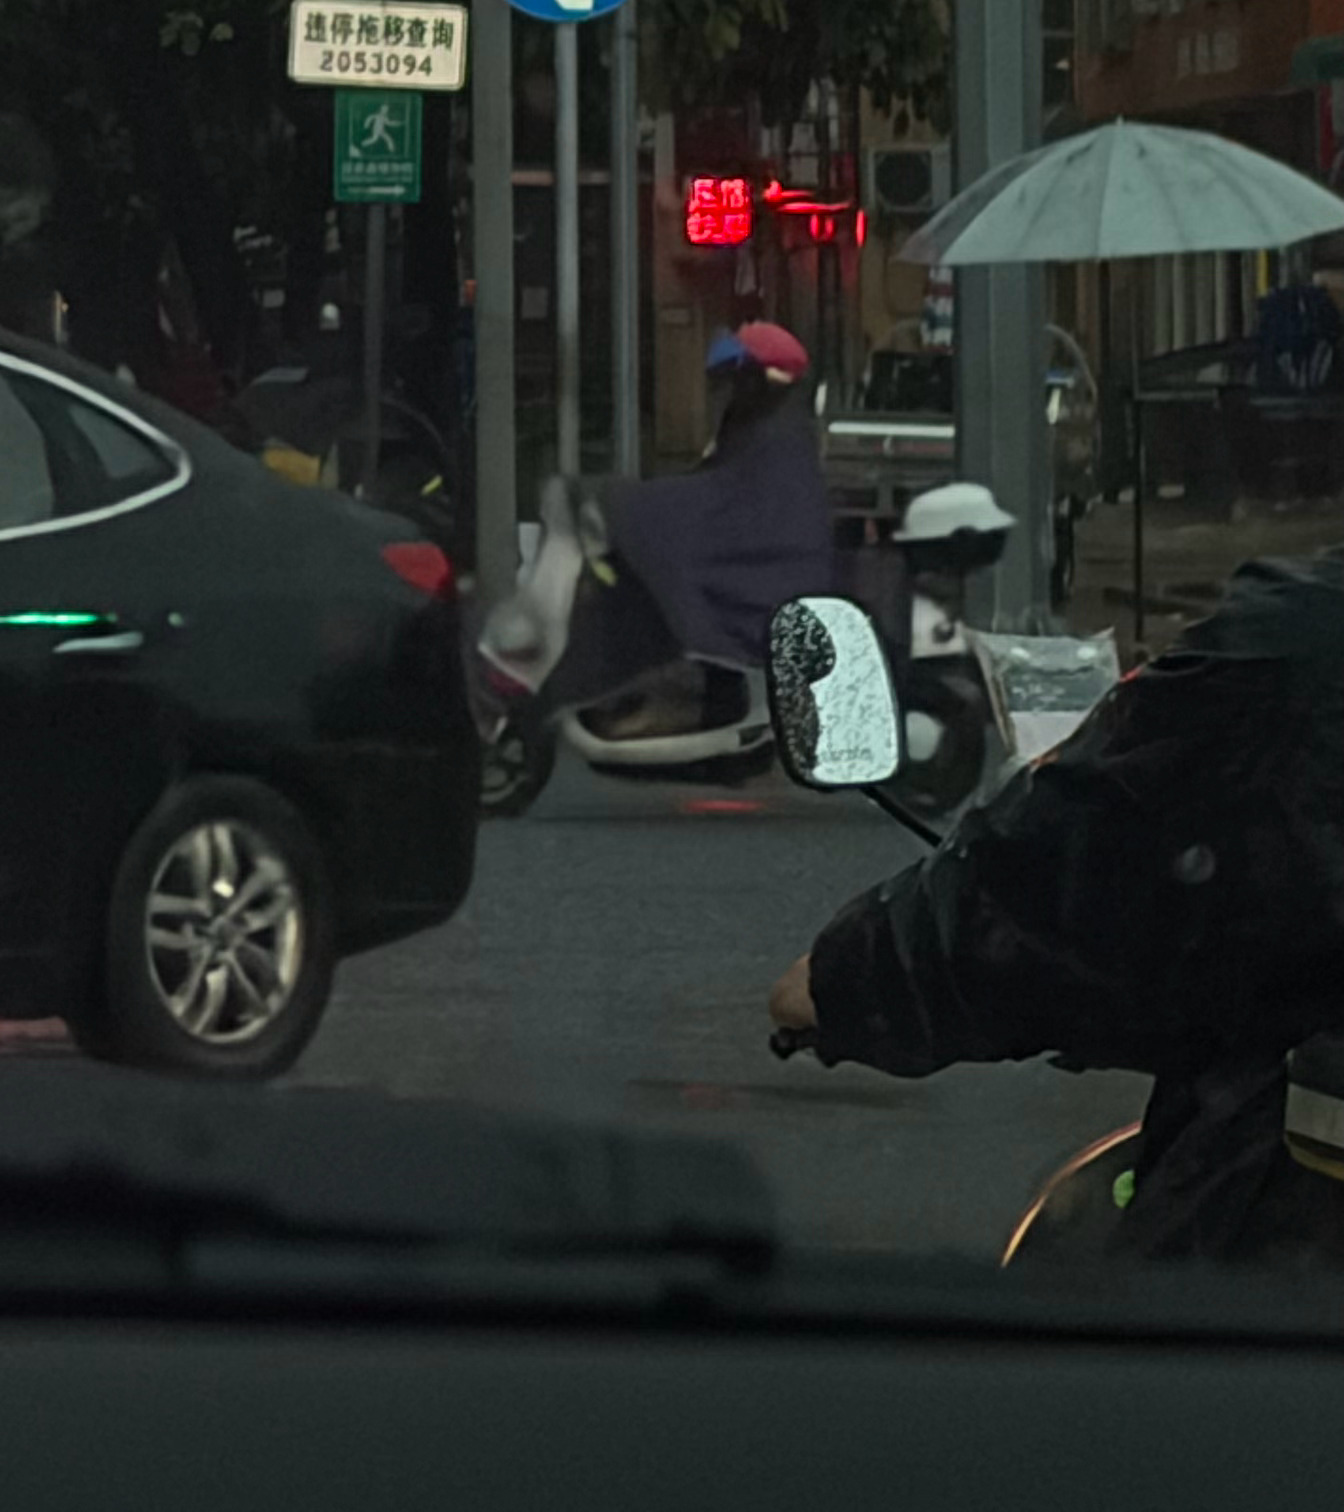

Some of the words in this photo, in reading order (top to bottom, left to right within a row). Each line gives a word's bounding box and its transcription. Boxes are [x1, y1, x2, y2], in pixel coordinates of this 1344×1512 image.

[304, 12, 455, 51] 违停拖移查询
[320, 49, 433, 76] 2053094
